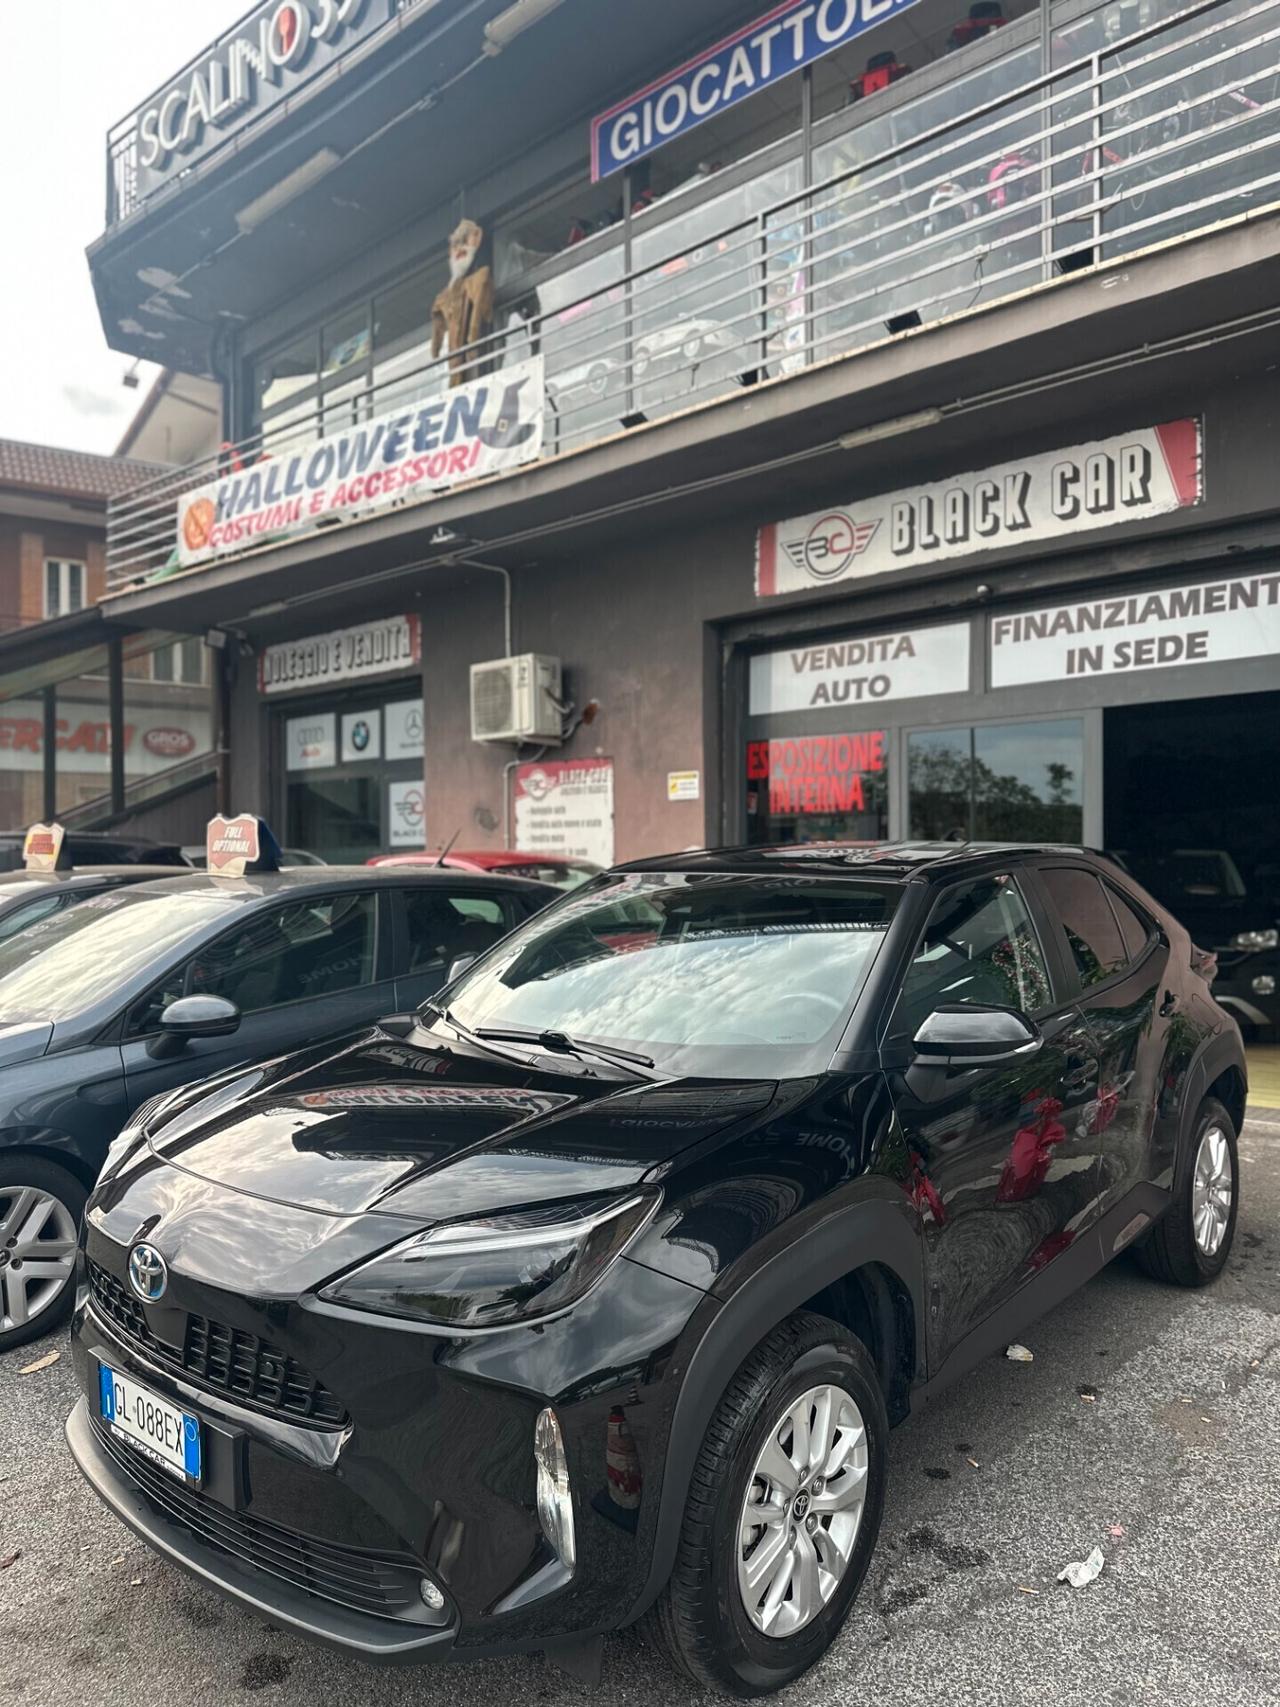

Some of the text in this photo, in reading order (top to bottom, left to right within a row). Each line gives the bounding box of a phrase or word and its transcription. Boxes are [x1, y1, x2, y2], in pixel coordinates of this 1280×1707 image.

[609, 0, 893, 161] GIOCATTOL
[213, 387, 488, 522] HALLOWEEN
[208, 439, 481, 547] COSTUMI E ACCESSORI
[891, 470, 1032, 556] BLACK
[1050, 444, 1152, 520] CAR
[994, 576, 1280, 646] FINANZIAMENT
[791, 635, 916, 673] VENDITA
[1066, 631, 1209, 675] IN SEDE
[809, 675, 891, 705] AUTO
[747, 731, 885, 779] ESPOSIZIONE
[769, 773, 865, 816] INTERNA
[212, 839, 250, 852] OPTIONAL
[224, 826, 243, 838] FULL
